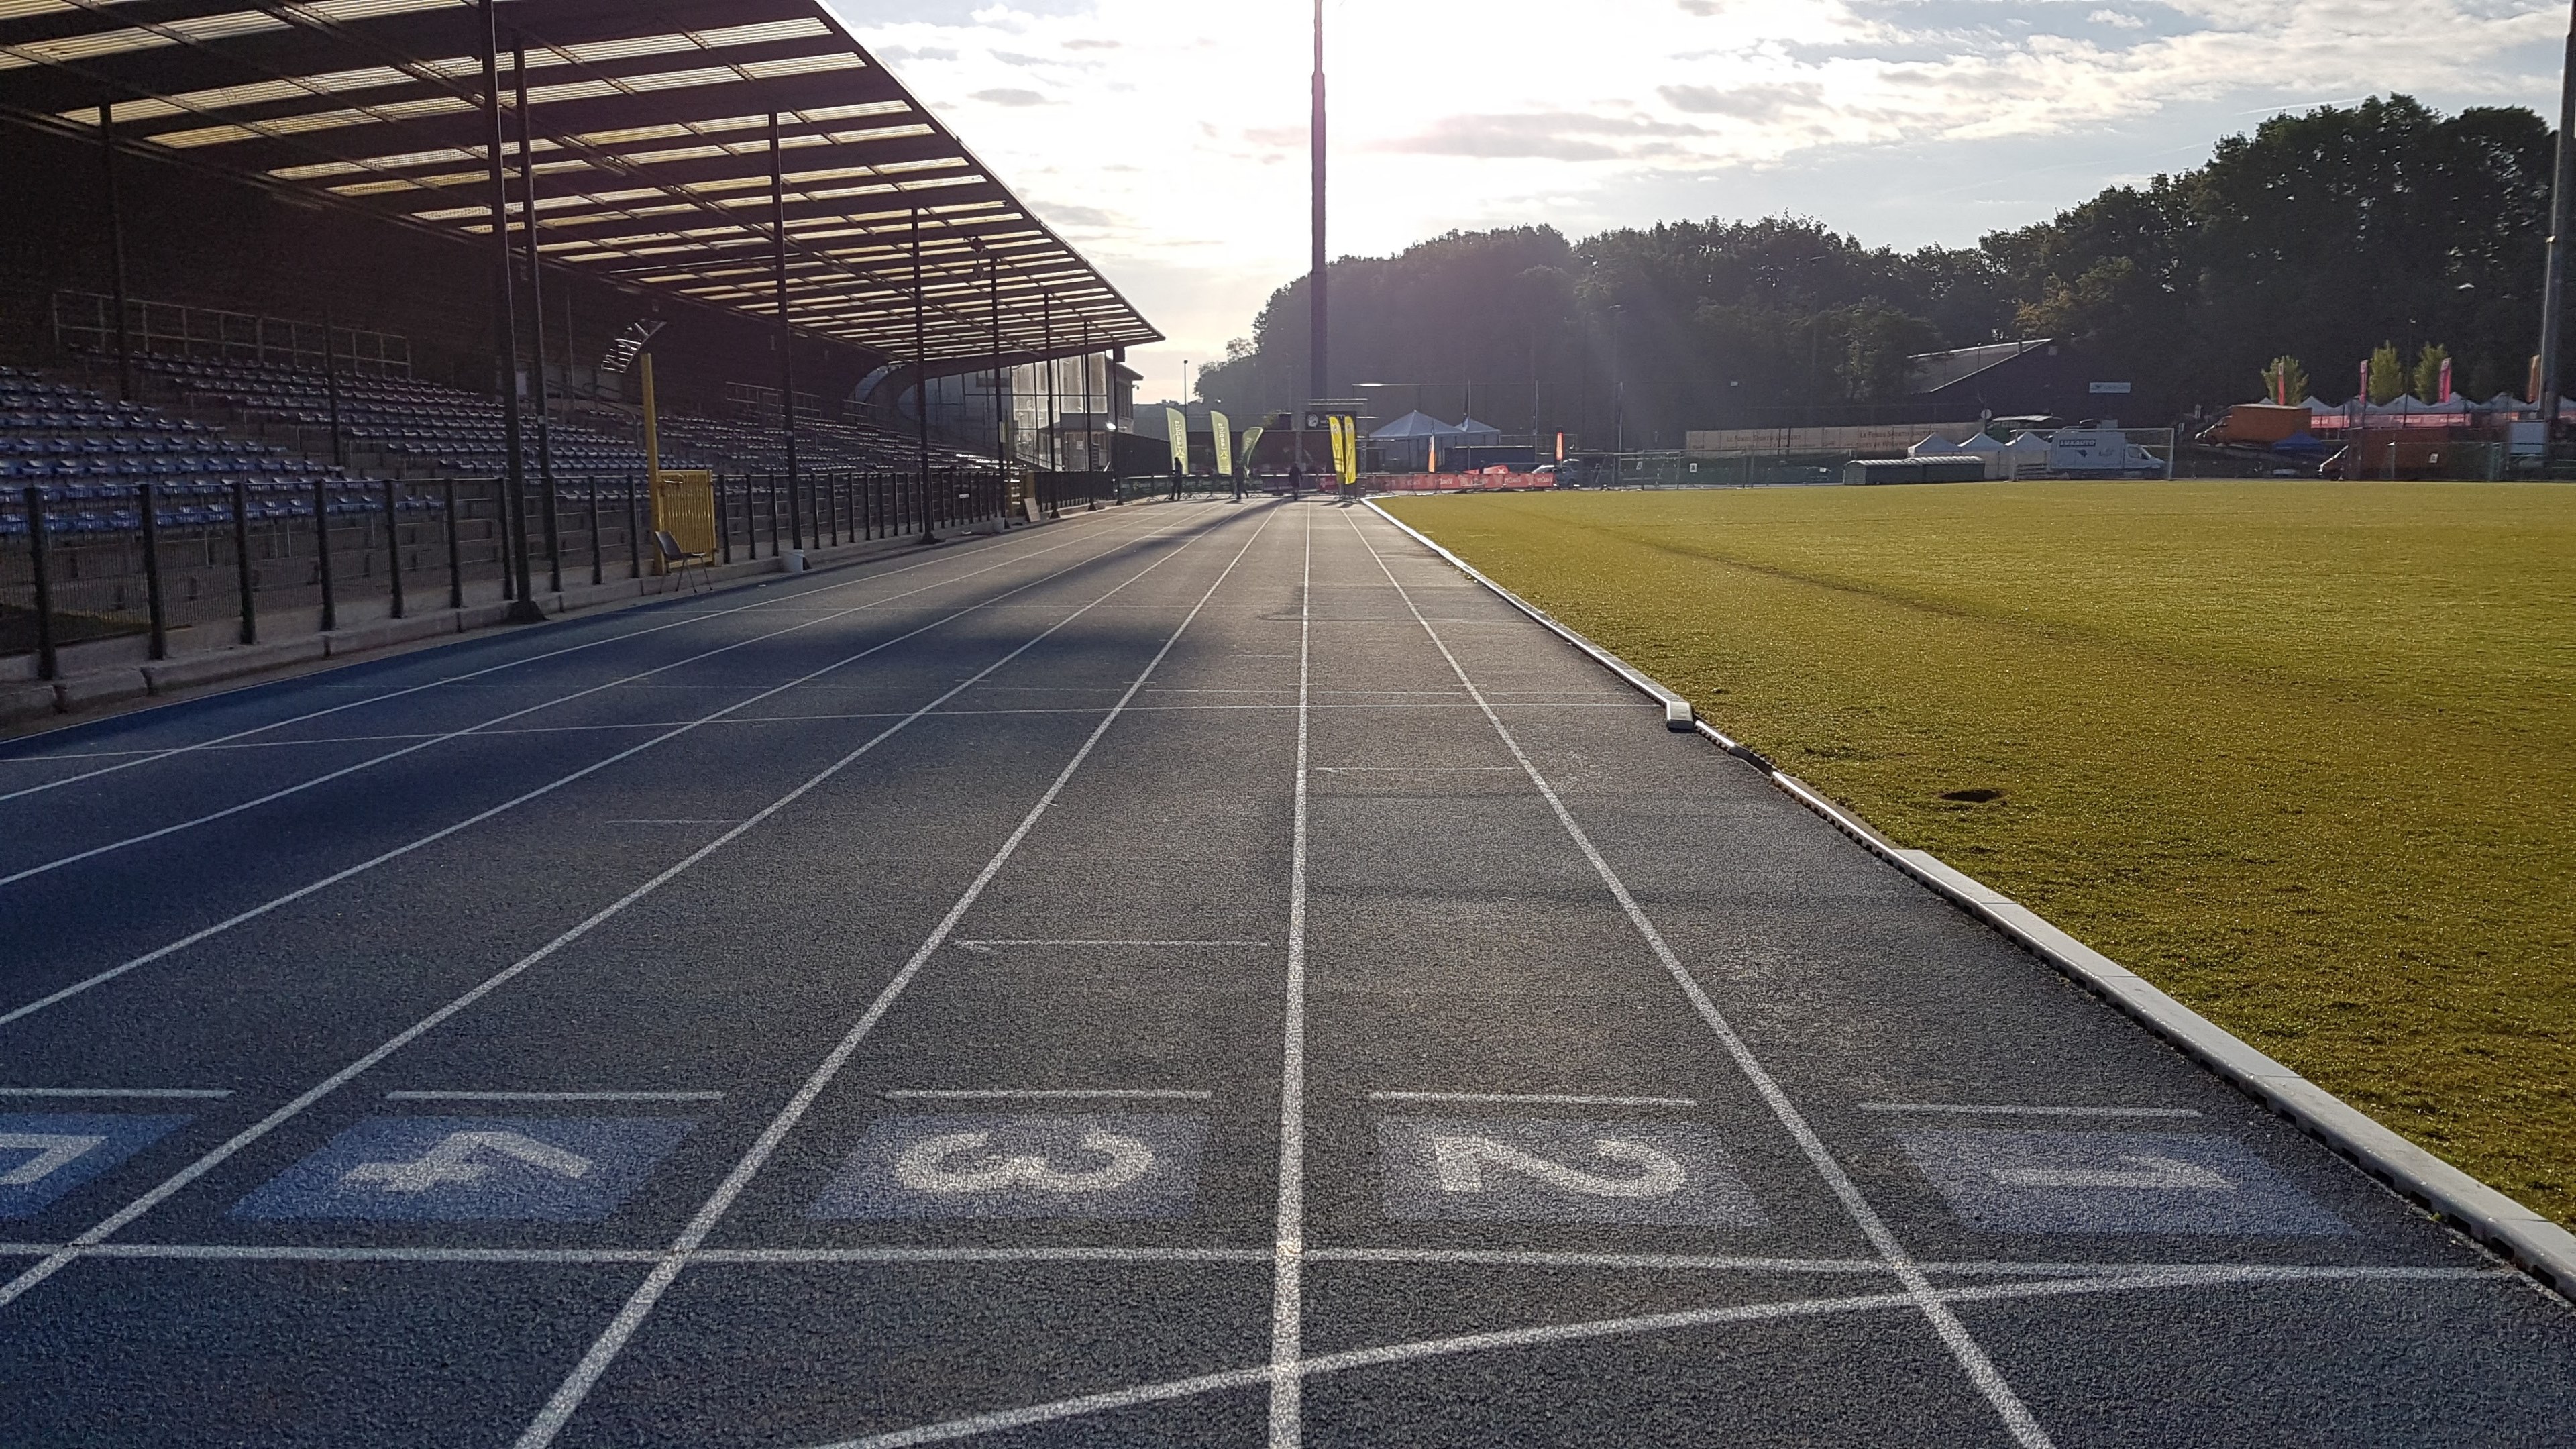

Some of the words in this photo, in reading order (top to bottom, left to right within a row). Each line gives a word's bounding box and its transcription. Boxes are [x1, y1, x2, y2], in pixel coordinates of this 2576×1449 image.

[339, 1130, 592, 1193] 4
[894, 1130, 1155, 1195] 3
[1433, 1135, 1684, 1197] 2
[1990, 1155, 2238, 1190] 1
